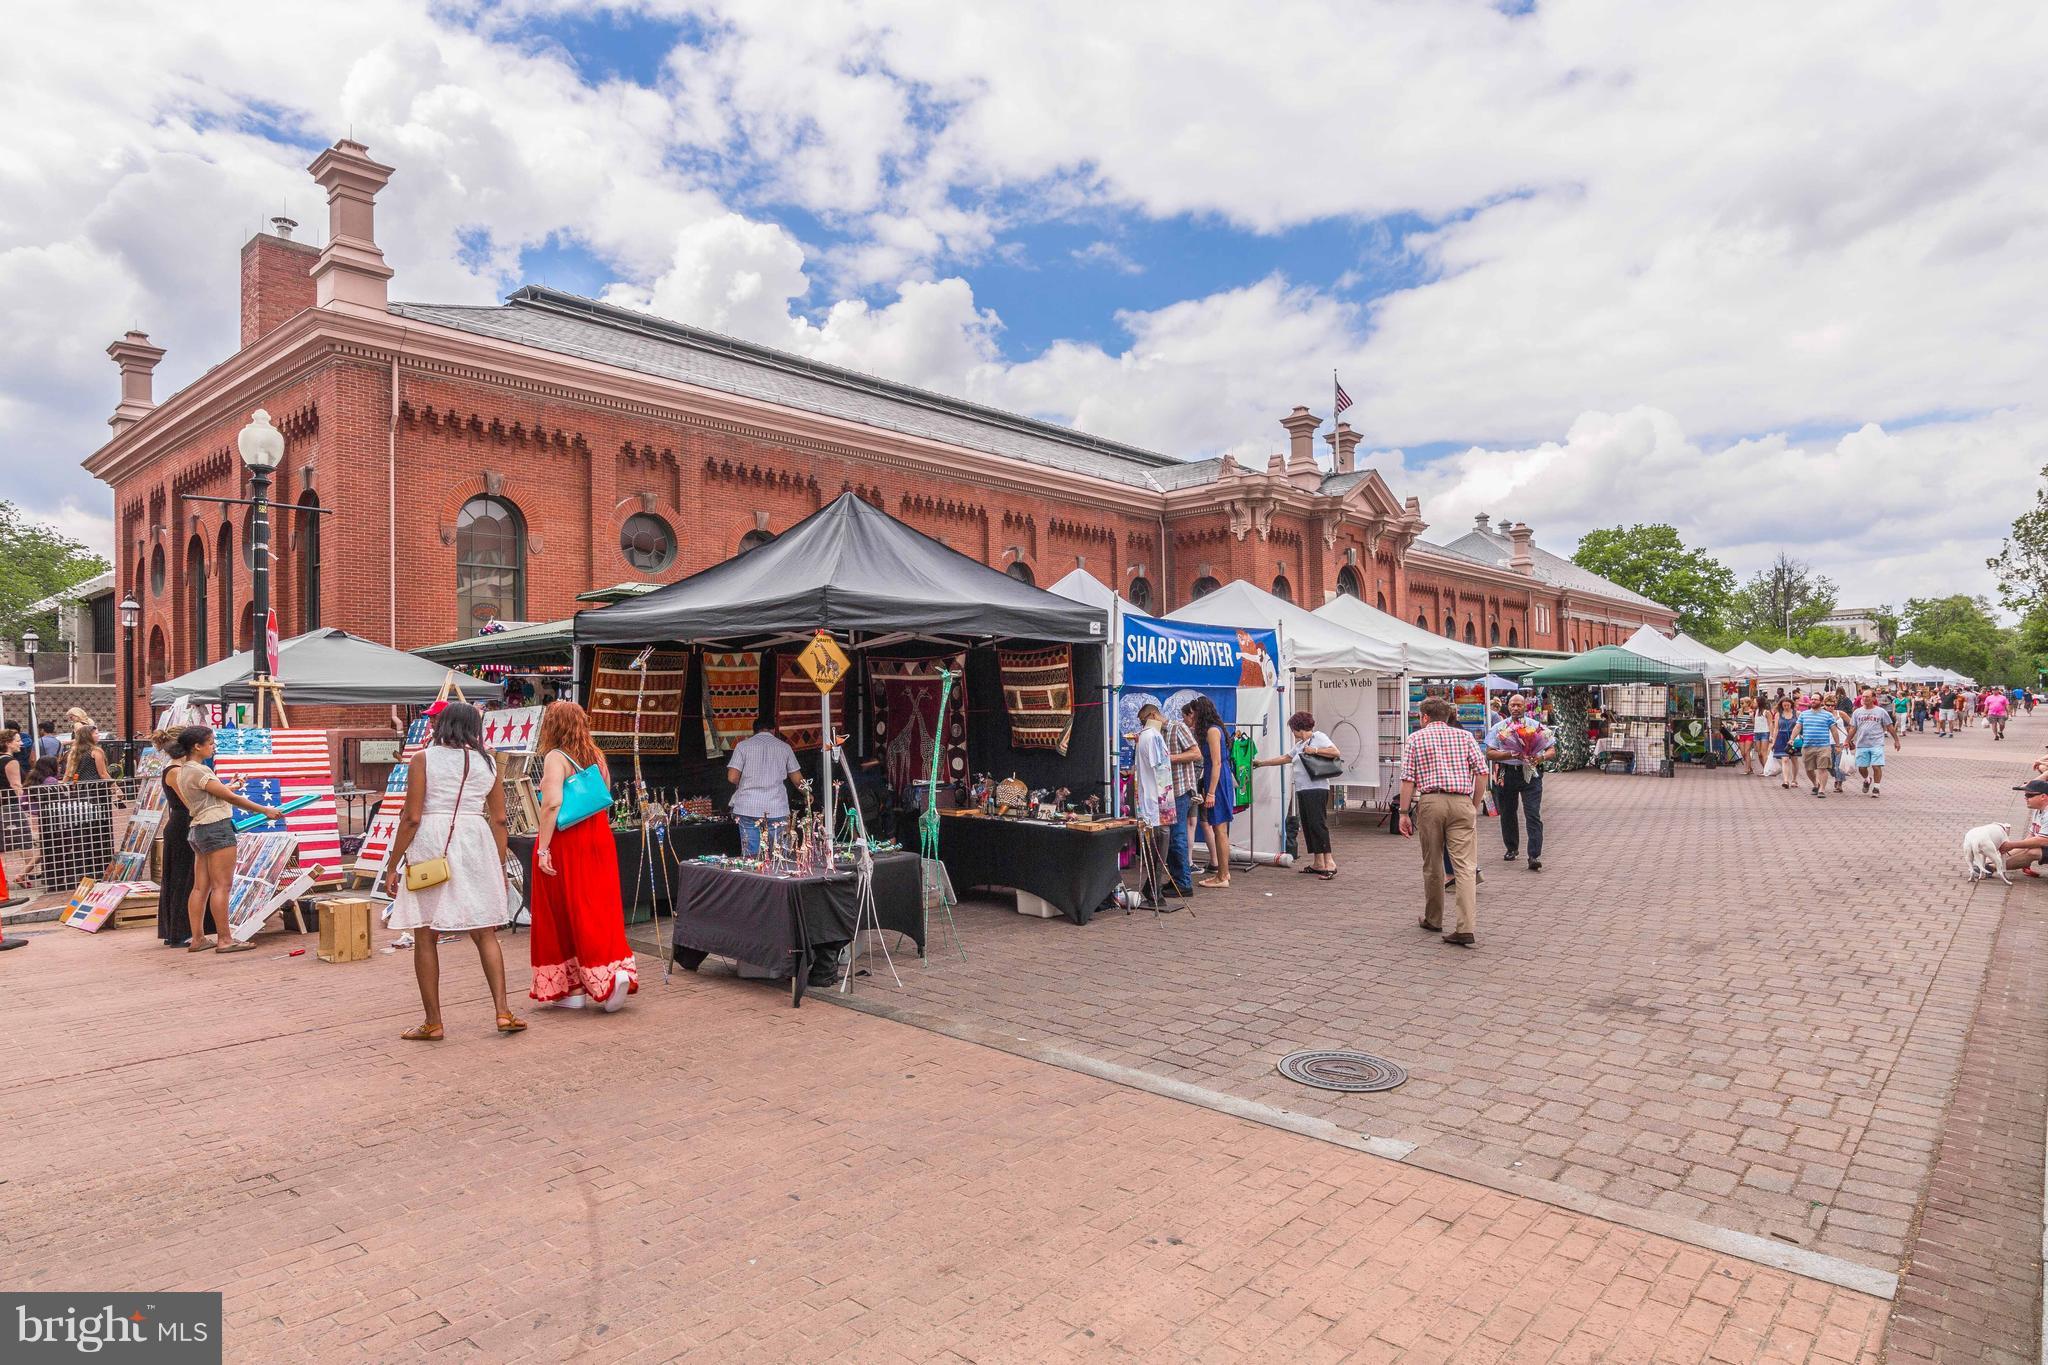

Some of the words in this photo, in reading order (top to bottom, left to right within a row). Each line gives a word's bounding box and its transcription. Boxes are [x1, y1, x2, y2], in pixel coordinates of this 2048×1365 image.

[1126, 634, 1177, 664] SHARP
[1180, 639, 1234, 667] SHIRTER
[1318, 679, 1348, 689] Turtle's
[1350, 677, 1372, 688] Webb
